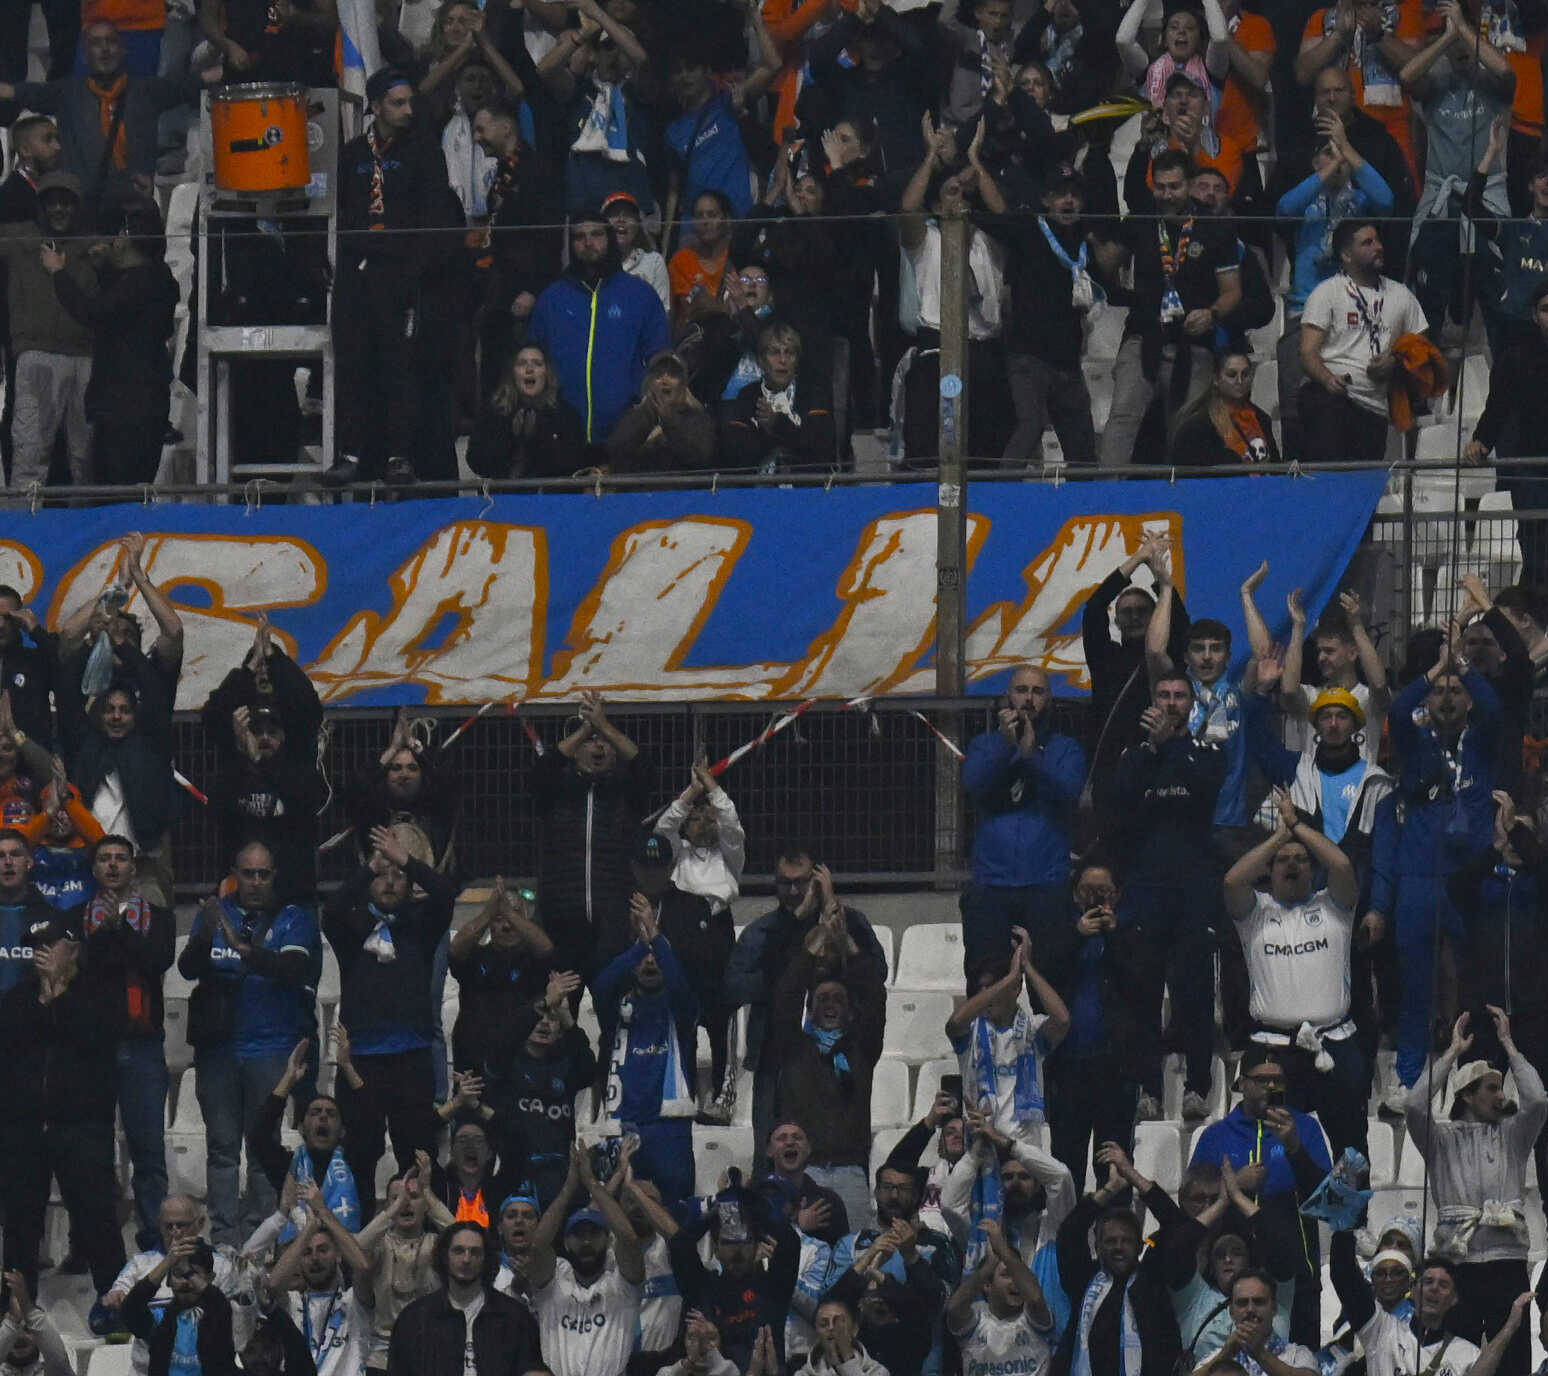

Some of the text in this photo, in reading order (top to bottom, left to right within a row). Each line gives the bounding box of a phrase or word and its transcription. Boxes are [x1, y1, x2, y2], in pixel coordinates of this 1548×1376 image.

[11, 946, 34, 960] CG
[1264, 938, 1329, 958] CMA CGM
[518, 1097, 572, 1121] CAOO
